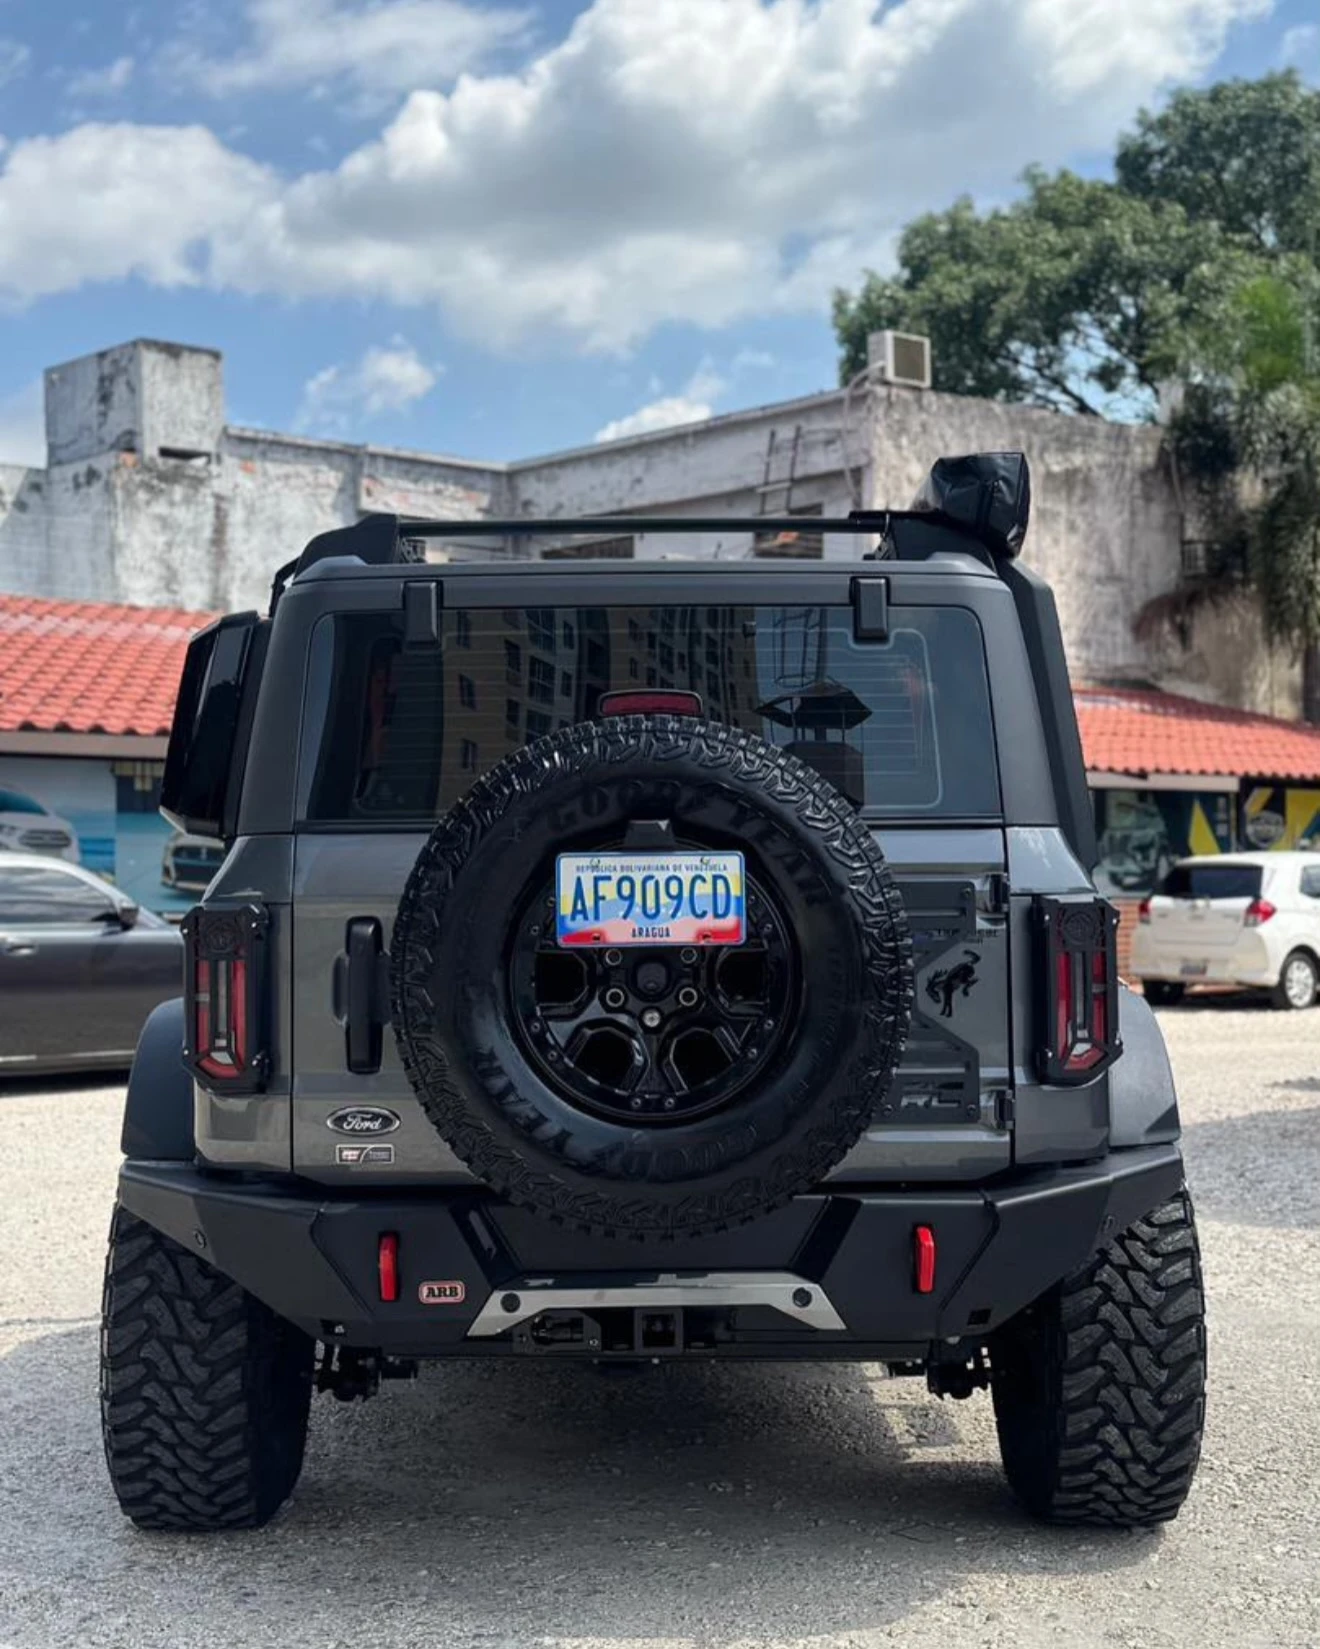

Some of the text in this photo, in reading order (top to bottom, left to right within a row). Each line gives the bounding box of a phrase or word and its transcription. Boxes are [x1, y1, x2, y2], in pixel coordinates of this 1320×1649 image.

[620, 864, 670, 873] BOLIVARIANA
[673, 864, 682, 873] DE
[685, 863, 727, 872] VENEZUELA
[570, 873, 731, 922] AF909CD
[631, 927, 670, 938] ARAGUA
[343, 1112, 382, 1130] Ford
[425, 1286, 459, 1298] ARB
